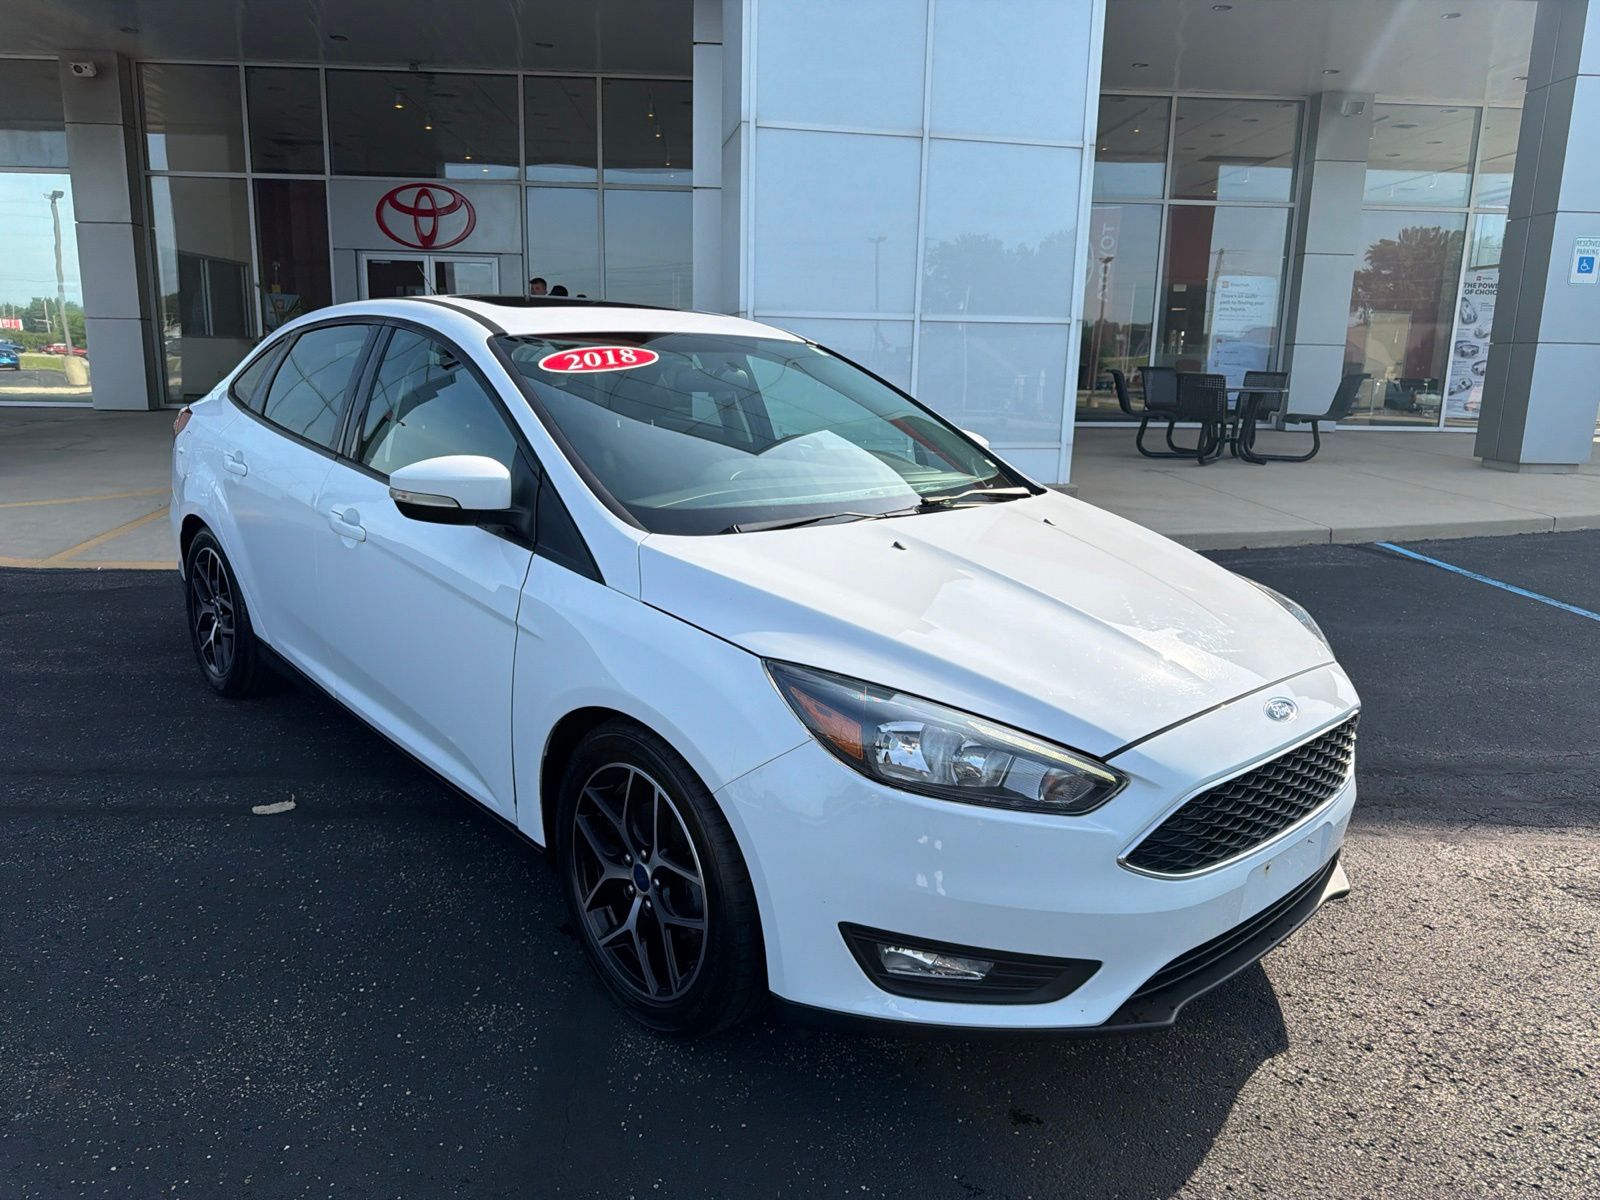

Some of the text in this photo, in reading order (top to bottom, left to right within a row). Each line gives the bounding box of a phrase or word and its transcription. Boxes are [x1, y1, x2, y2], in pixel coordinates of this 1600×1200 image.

[1576, 247, 1600, 255] PARKING
[563, 349, 638, 370] 2018
[1269, 702, 1294, 719] Ford
